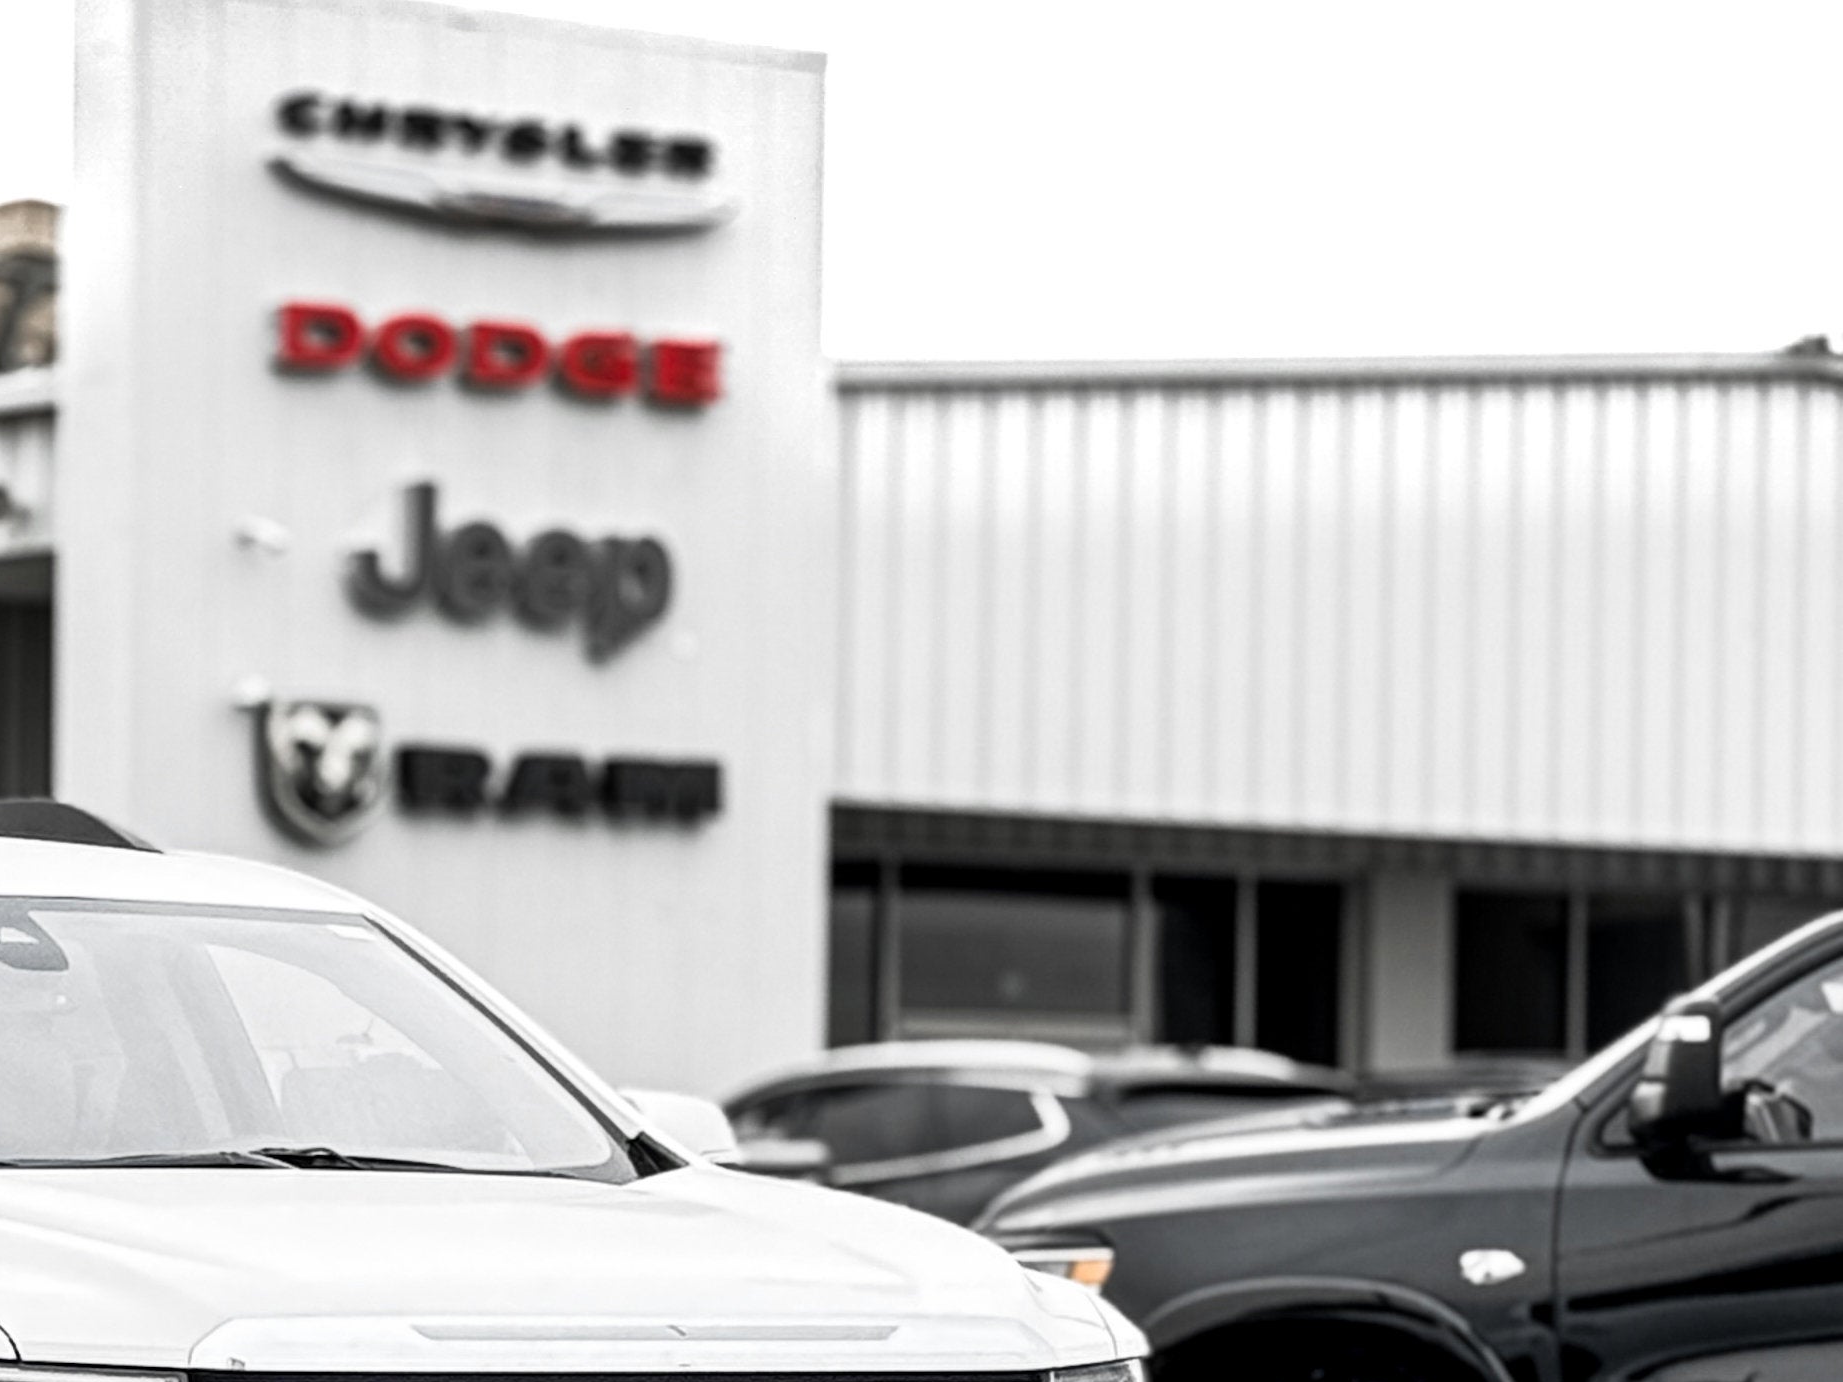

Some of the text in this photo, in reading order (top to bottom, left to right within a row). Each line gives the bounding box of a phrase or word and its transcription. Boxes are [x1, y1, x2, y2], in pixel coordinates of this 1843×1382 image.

[274, 93, 716, 180] CHRYSLER
[274, 302, 722, 406] DODGE
[344, 480, 674, 662] Jeep
[392, 742, 722, 830] RAM
